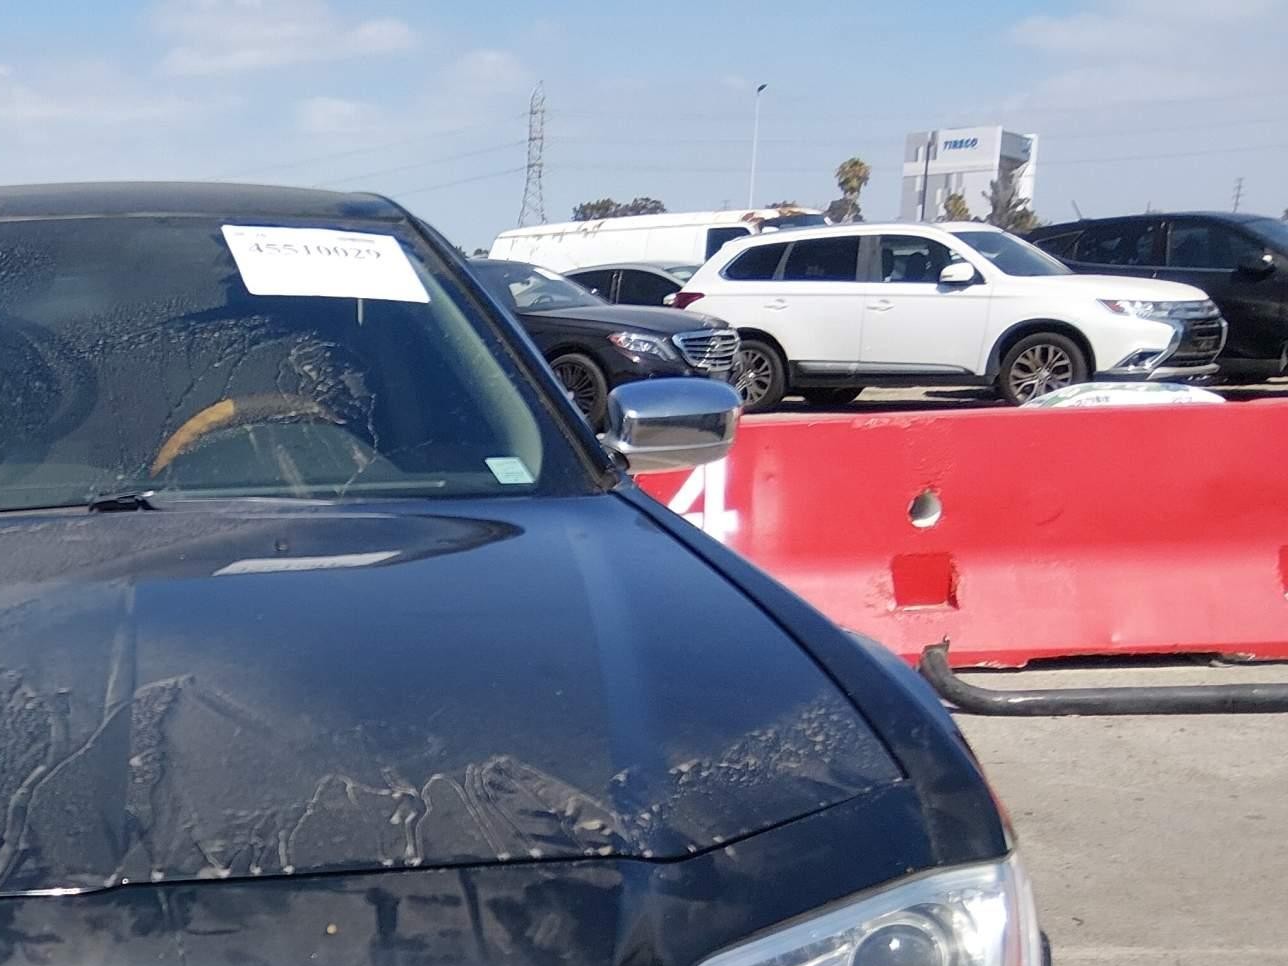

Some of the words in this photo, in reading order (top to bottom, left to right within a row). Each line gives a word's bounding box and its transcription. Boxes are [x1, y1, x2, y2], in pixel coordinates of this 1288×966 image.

[943, 137, 978, 150] TIRECO
[249, 241, 382, 260] 45510029
[666, 457, 740, 545] 4
